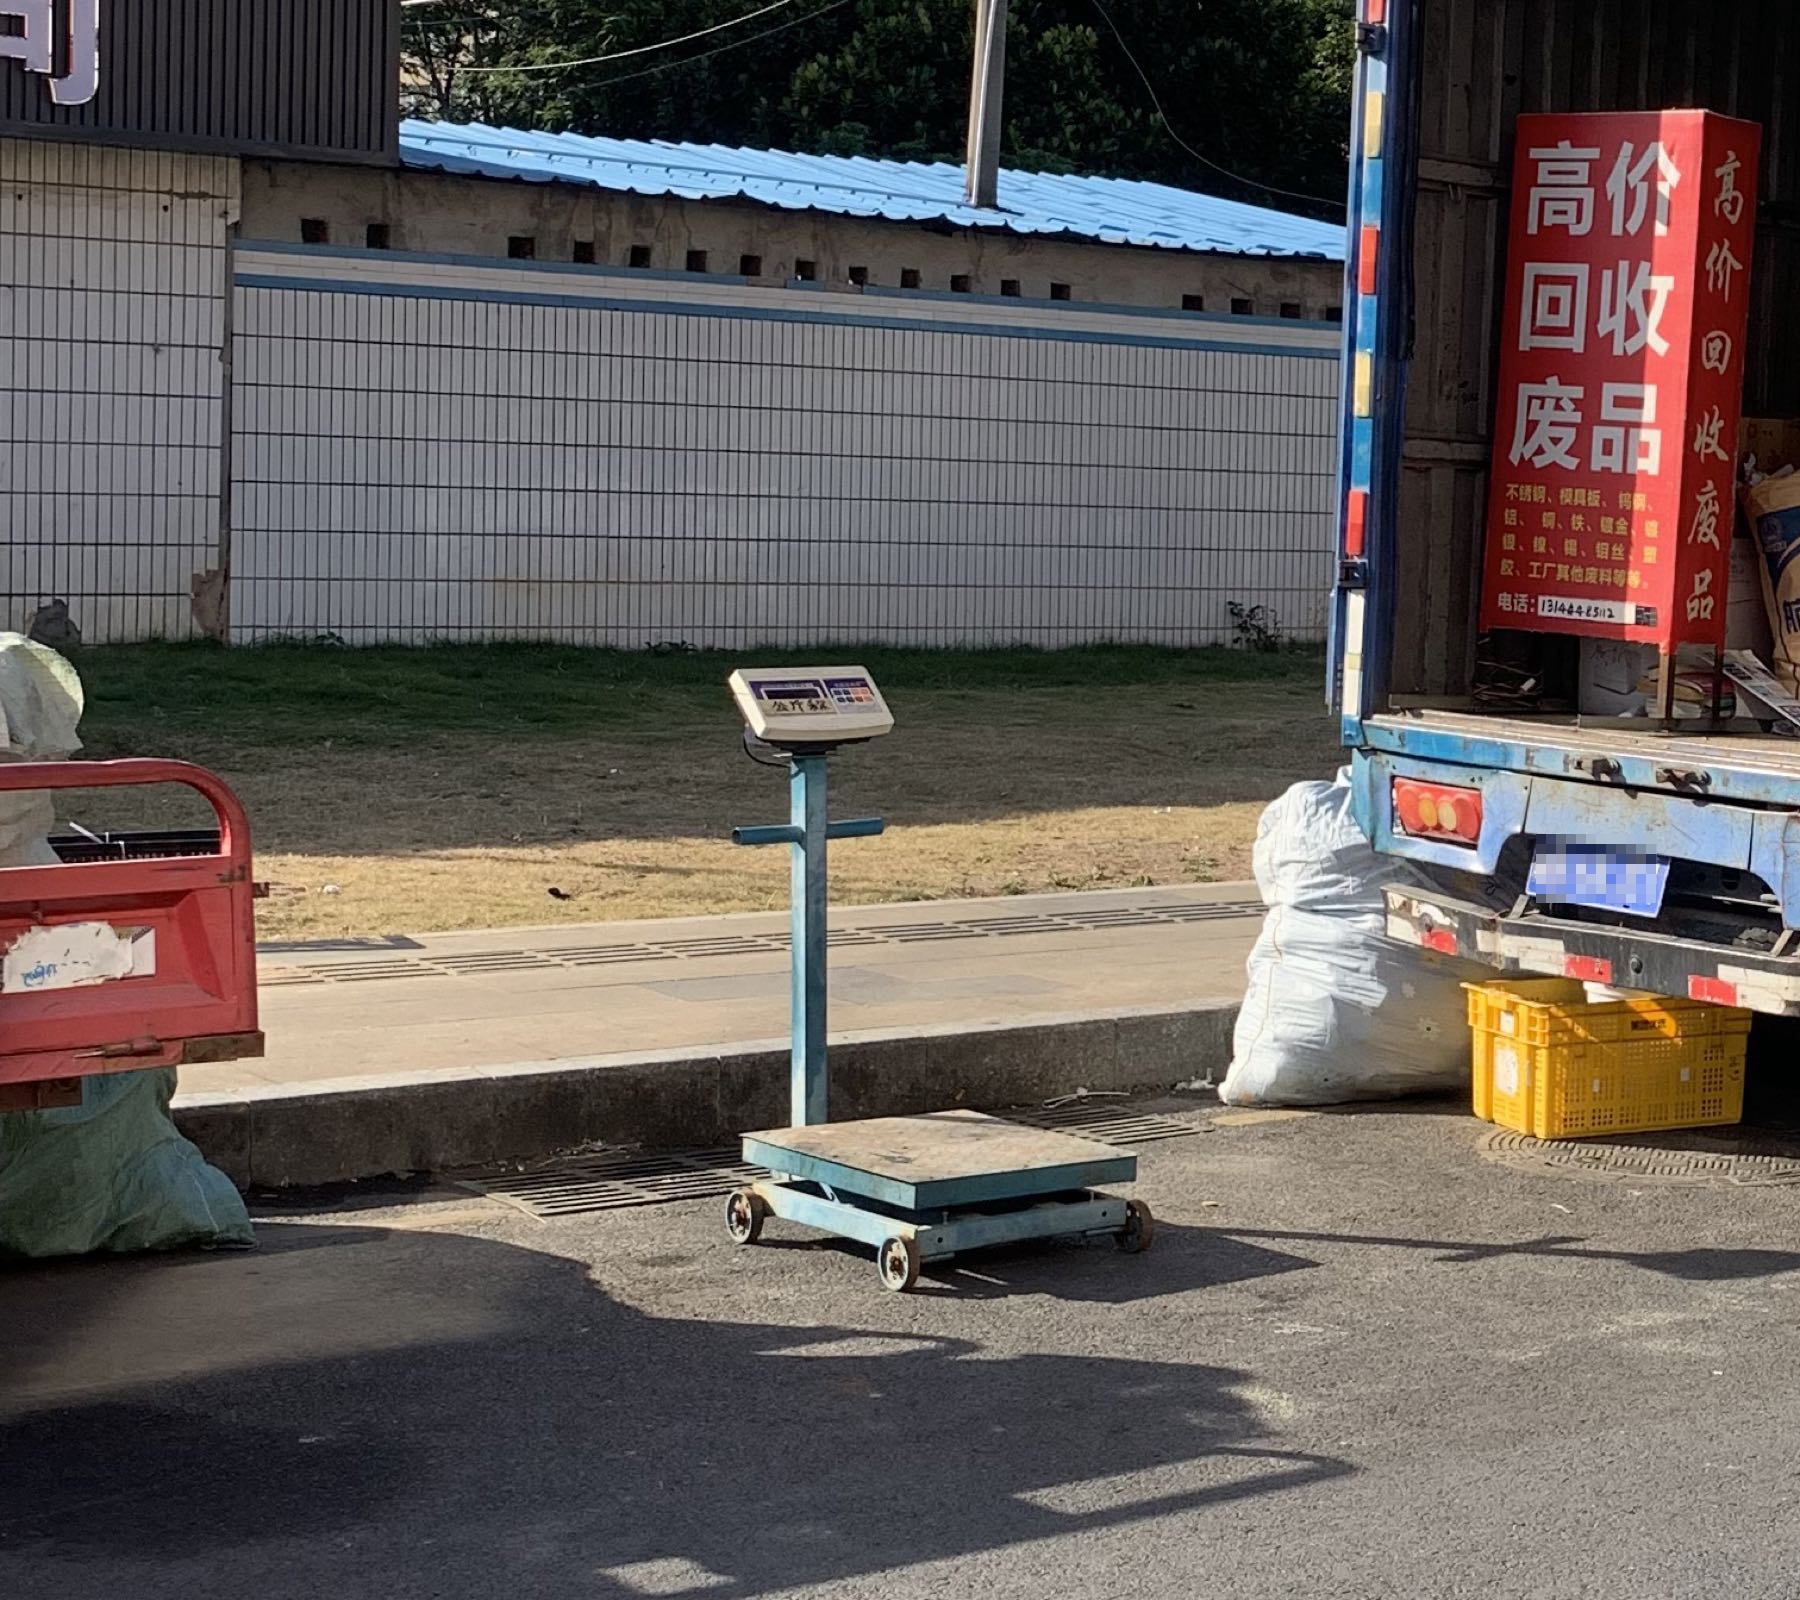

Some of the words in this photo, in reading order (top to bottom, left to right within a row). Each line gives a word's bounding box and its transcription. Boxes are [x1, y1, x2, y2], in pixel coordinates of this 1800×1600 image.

[1526, 139, 1681, 236] 高价
[1518, 259, 1675, 357] 回收
[1508, 375, 1662, 476] 废品
[1686, 150, 1744, 622] 高价回收废品
